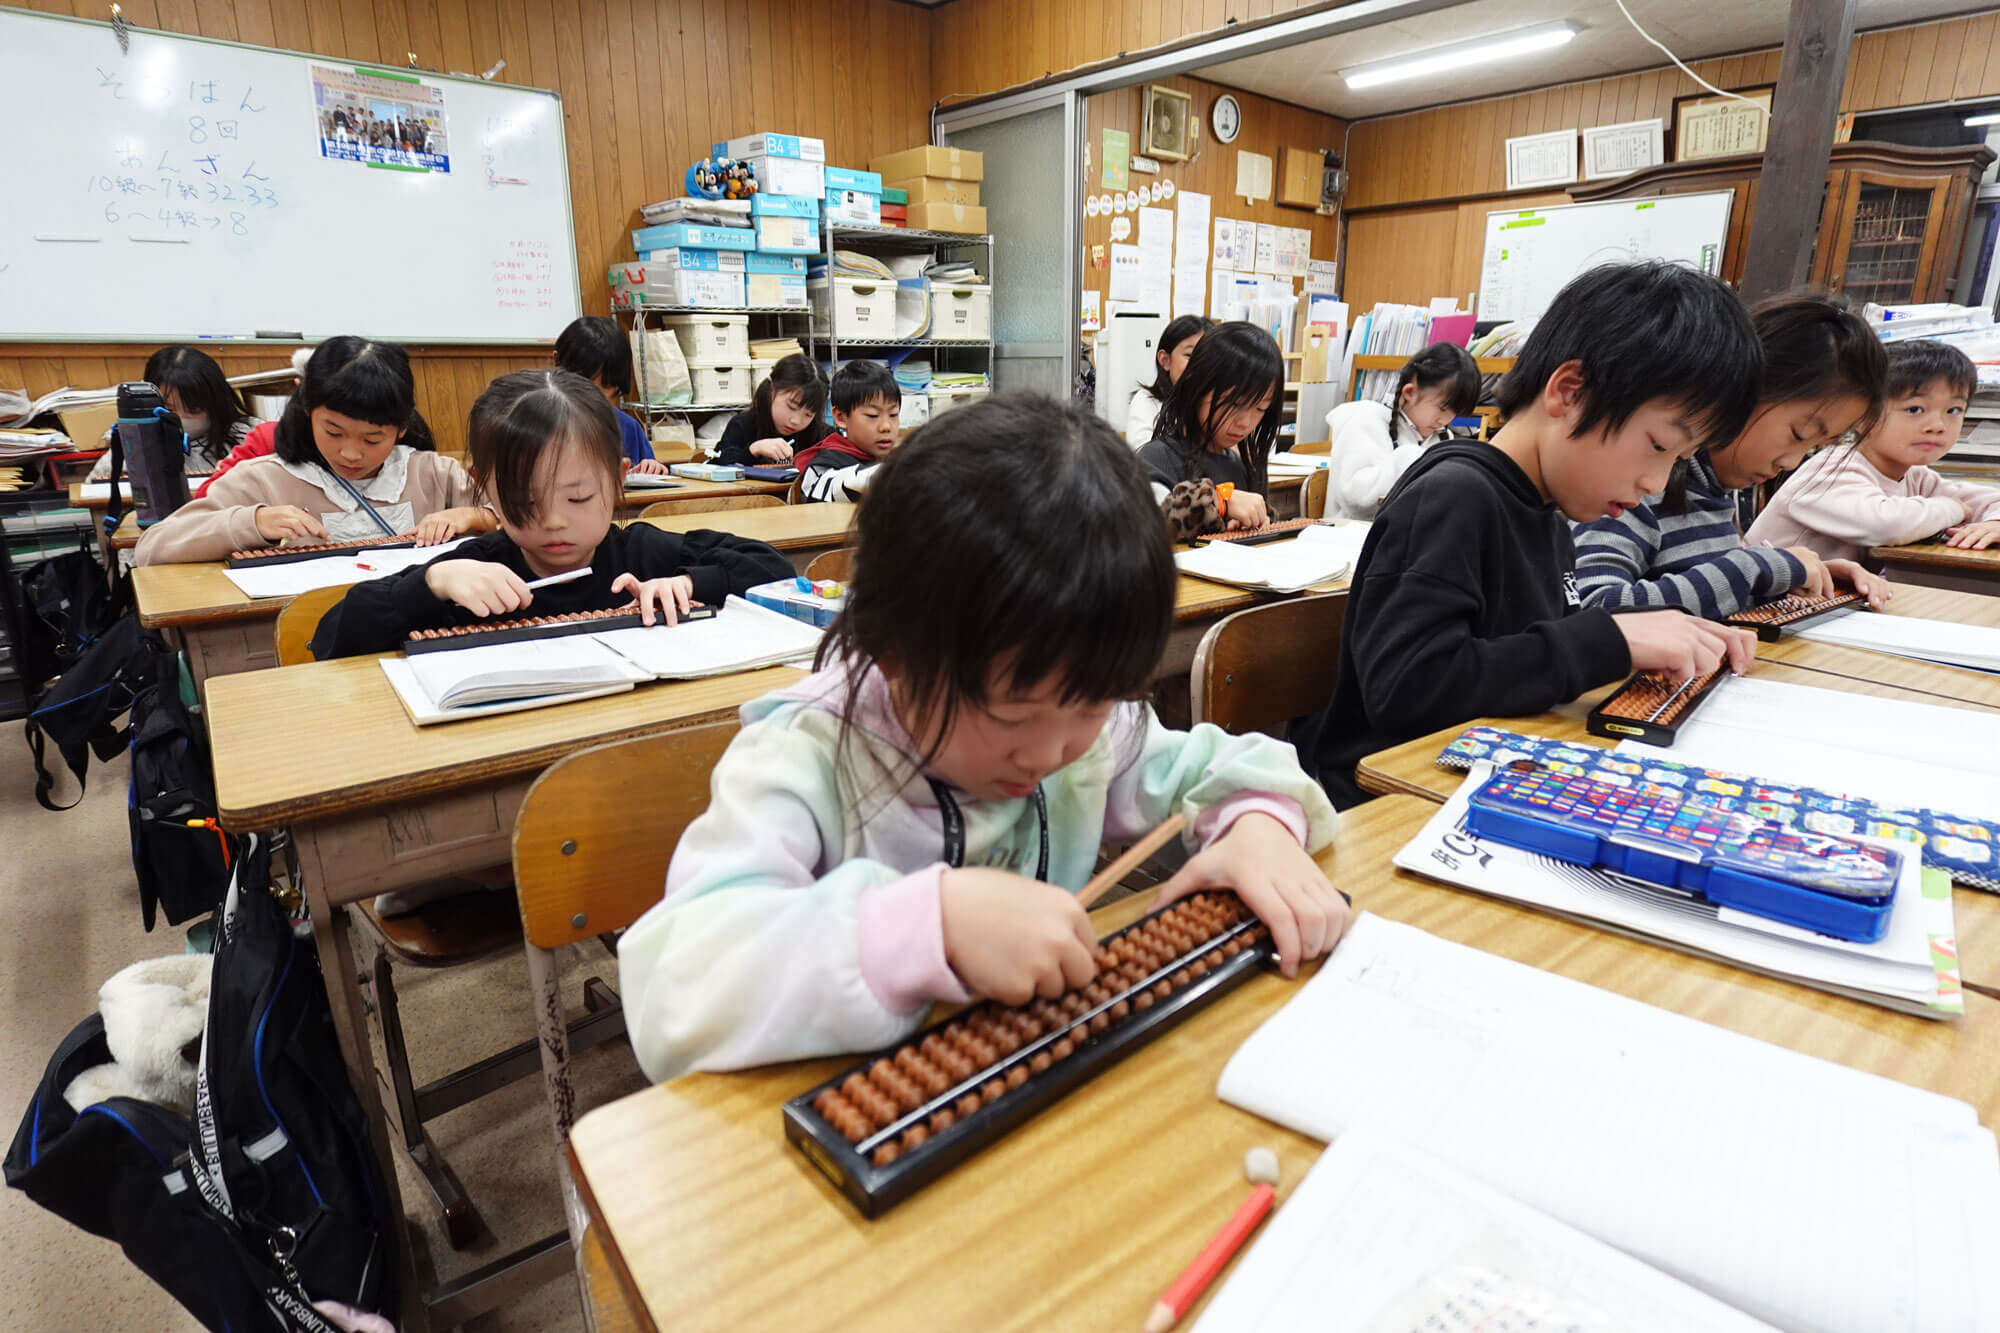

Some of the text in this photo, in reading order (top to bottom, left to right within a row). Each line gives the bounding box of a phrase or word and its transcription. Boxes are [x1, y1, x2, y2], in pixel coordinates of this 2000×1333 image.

[96, 66, 267, 112] そばん
[188, 115, 239, 144] 8回
[767, 136, 784, 154] B4
[680, 251, 700, 268] B4
